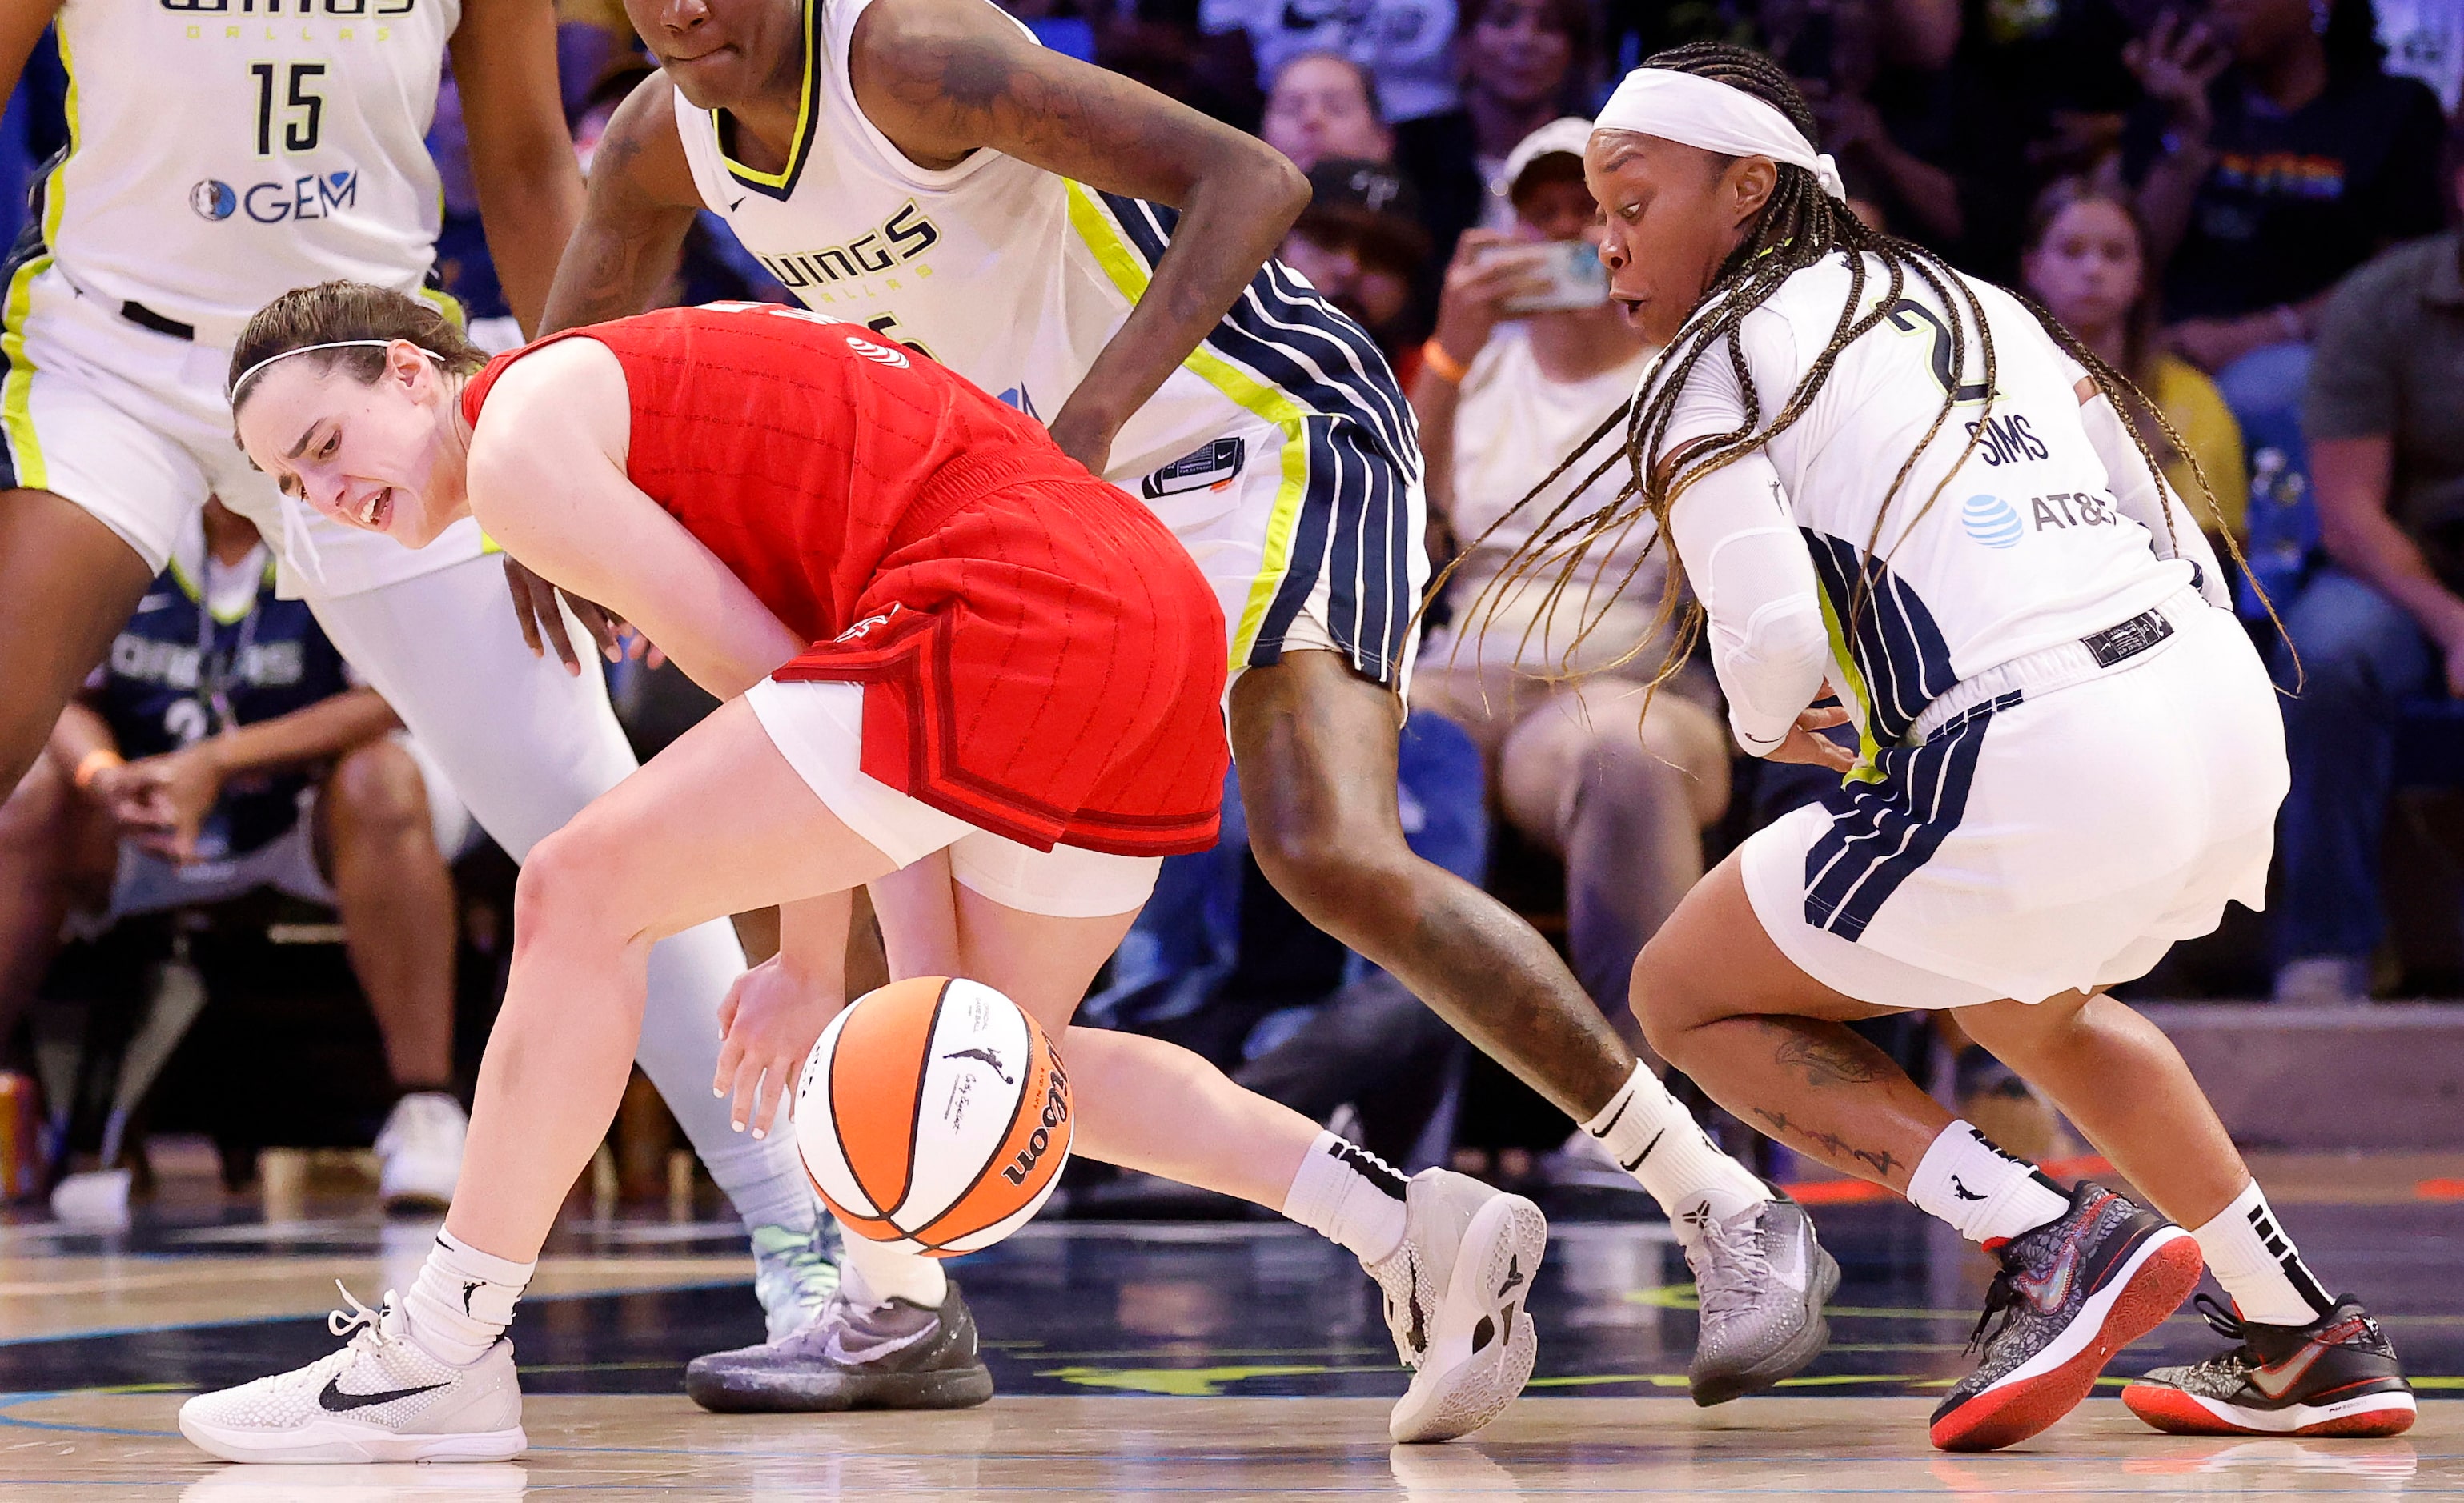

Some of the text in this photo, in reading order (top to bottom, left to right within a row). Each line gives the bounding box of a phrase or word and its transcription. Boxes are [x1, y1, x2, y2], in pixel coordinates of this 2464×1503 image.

[186, 25, 391, 42] DALLAS
[248, 61, 330, 158] 15
[243, 168, 358, 224] GEM
[801, 263, 933, 306] ALLAS
[1870, 298, 2008, 406] 2
[1964, 414, 2049, 467] SIMS
[1001, 1028, 1069, 1186] Wilson
